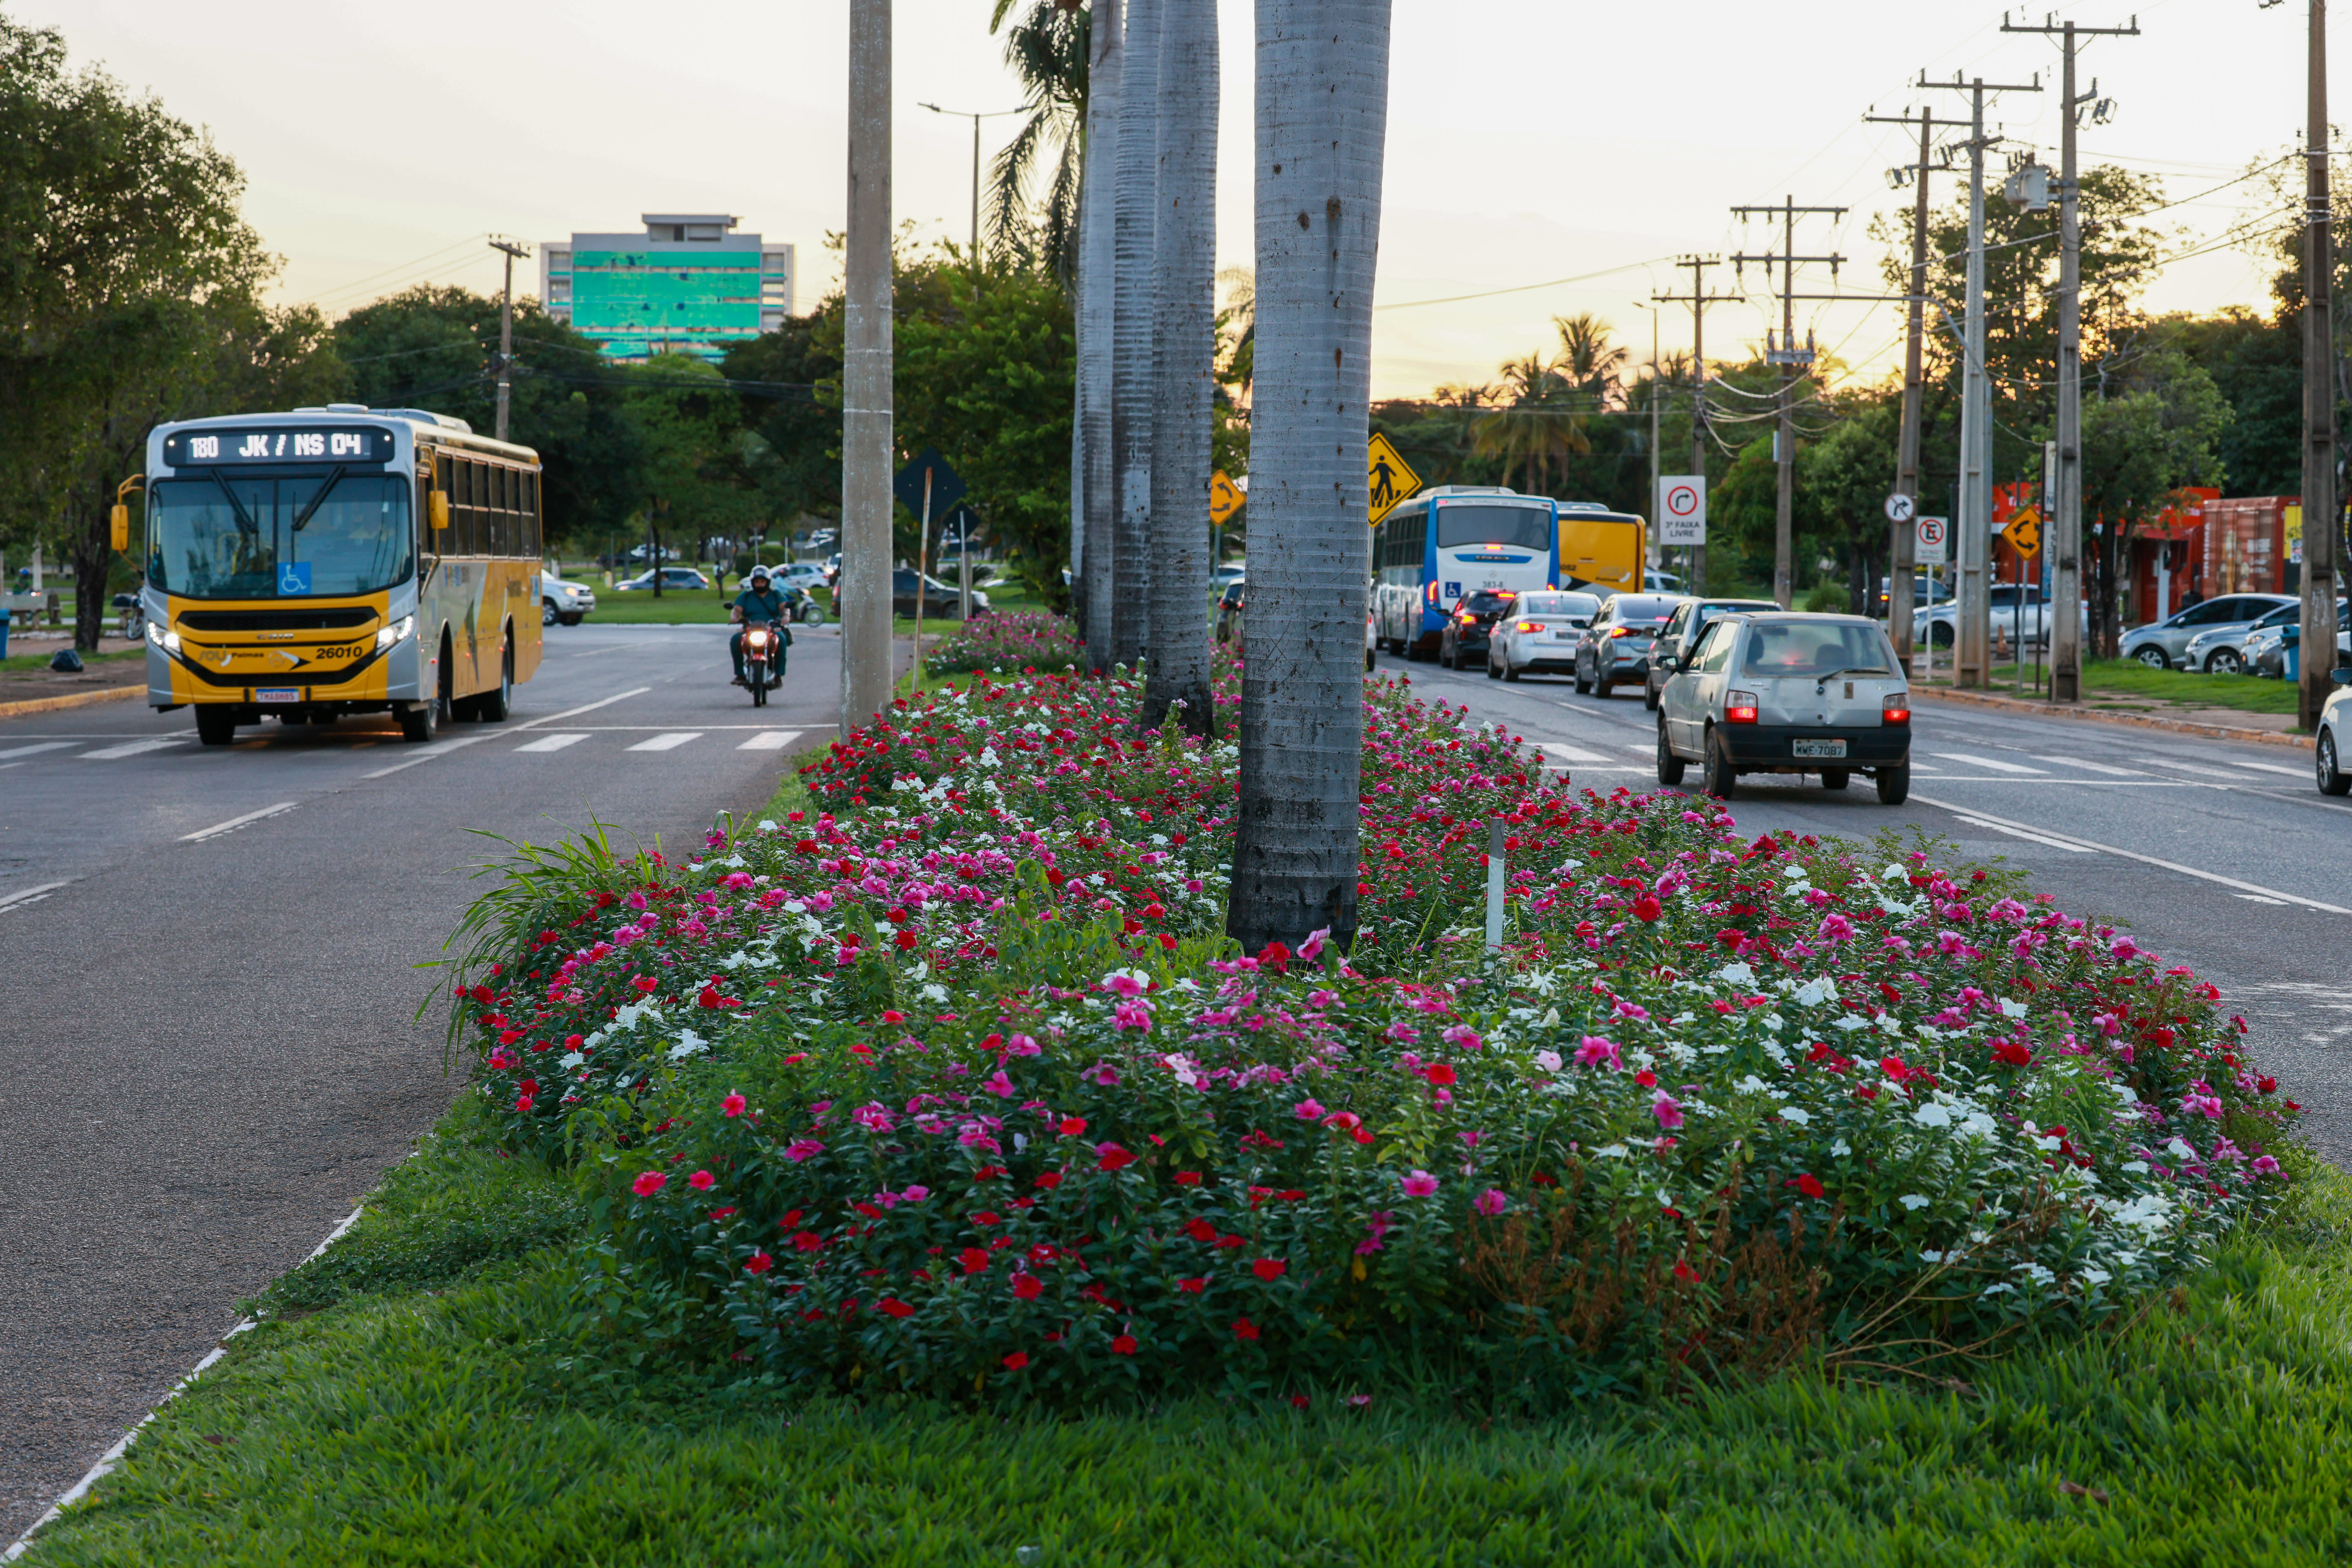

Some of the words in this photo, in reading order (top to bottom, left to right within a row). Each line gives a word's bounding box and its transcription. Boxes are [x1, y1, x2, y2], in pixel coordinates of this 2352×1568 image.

[190, 436, 218, 457] 180
[239, 435, 268, 457] JK
[275, 434, 286, 455] /
[294, 433, 325, 455] NS
[330, 433, 361, 455] 04
[315, 646, 363, 659] 26010
